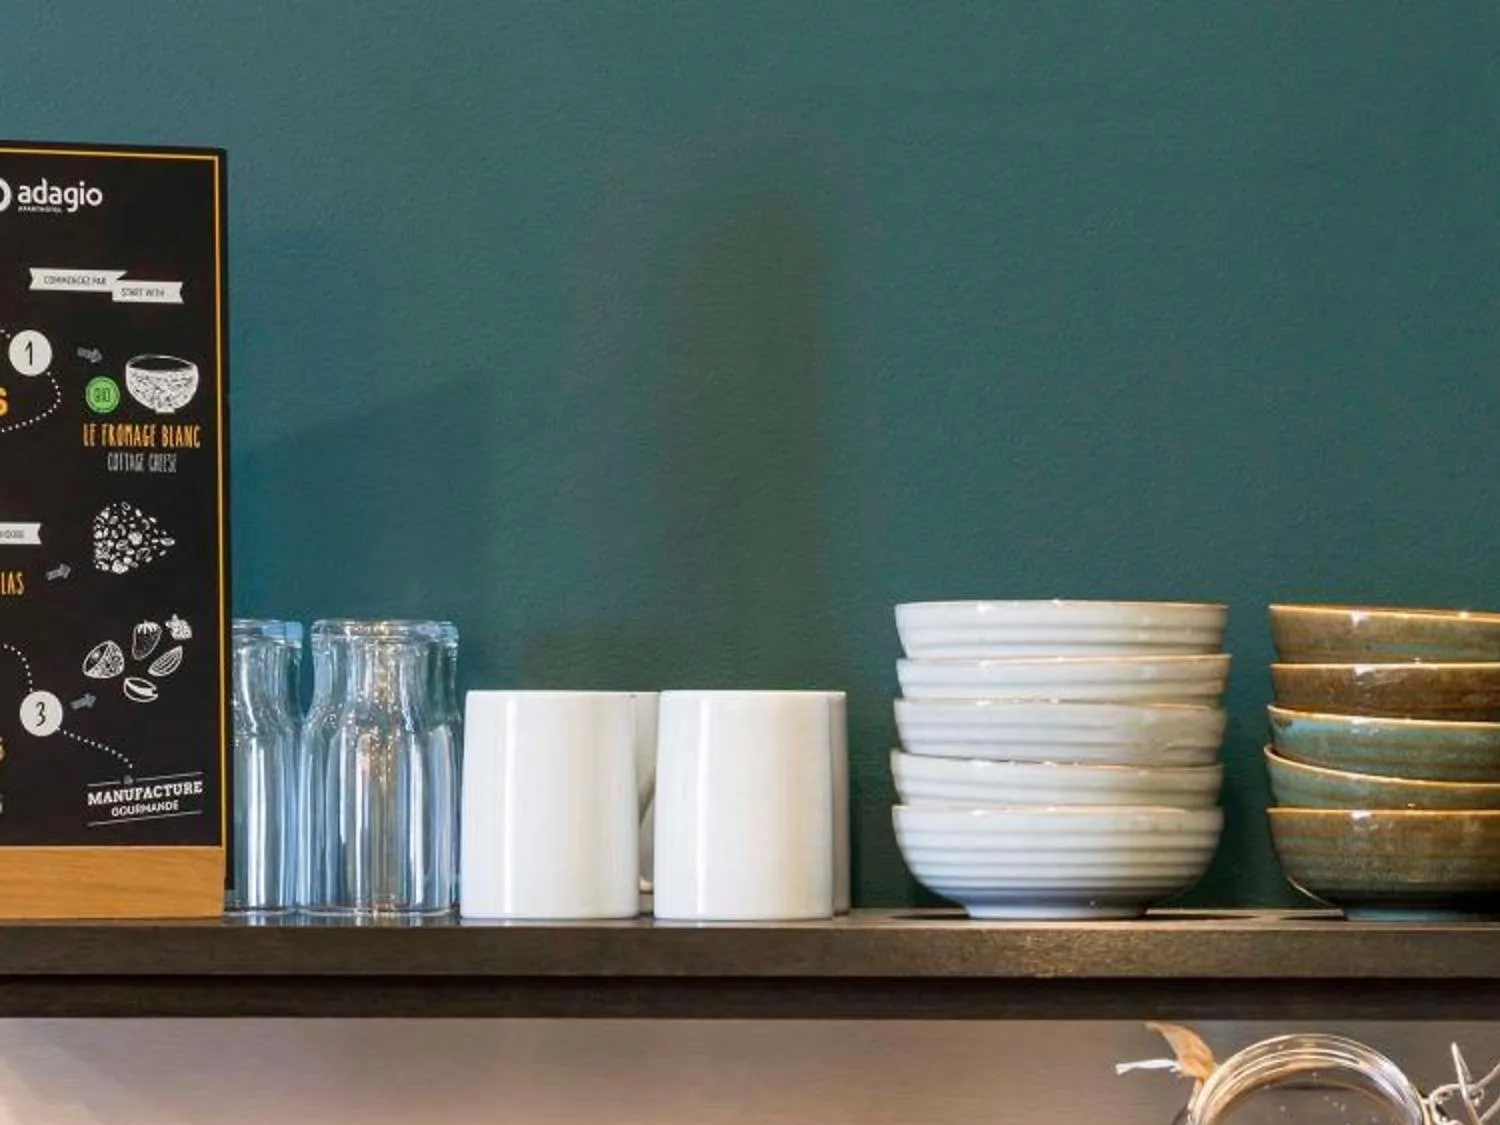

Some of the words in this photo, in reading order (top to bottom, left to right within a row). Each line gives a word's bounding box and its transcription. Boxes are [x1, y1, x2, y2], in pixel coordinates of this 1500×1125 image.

[17, 177, 103, 212] adagio
[25, 340, 33, 367] 1
[83, 423, 97, 448] LE
[101, 423, 156, 449] FROMAGE
[161, 424, 201, 449] BLANC
[35, 701, 47, 728] 3
[87, 780, 203, 807] MANUFACTURE
